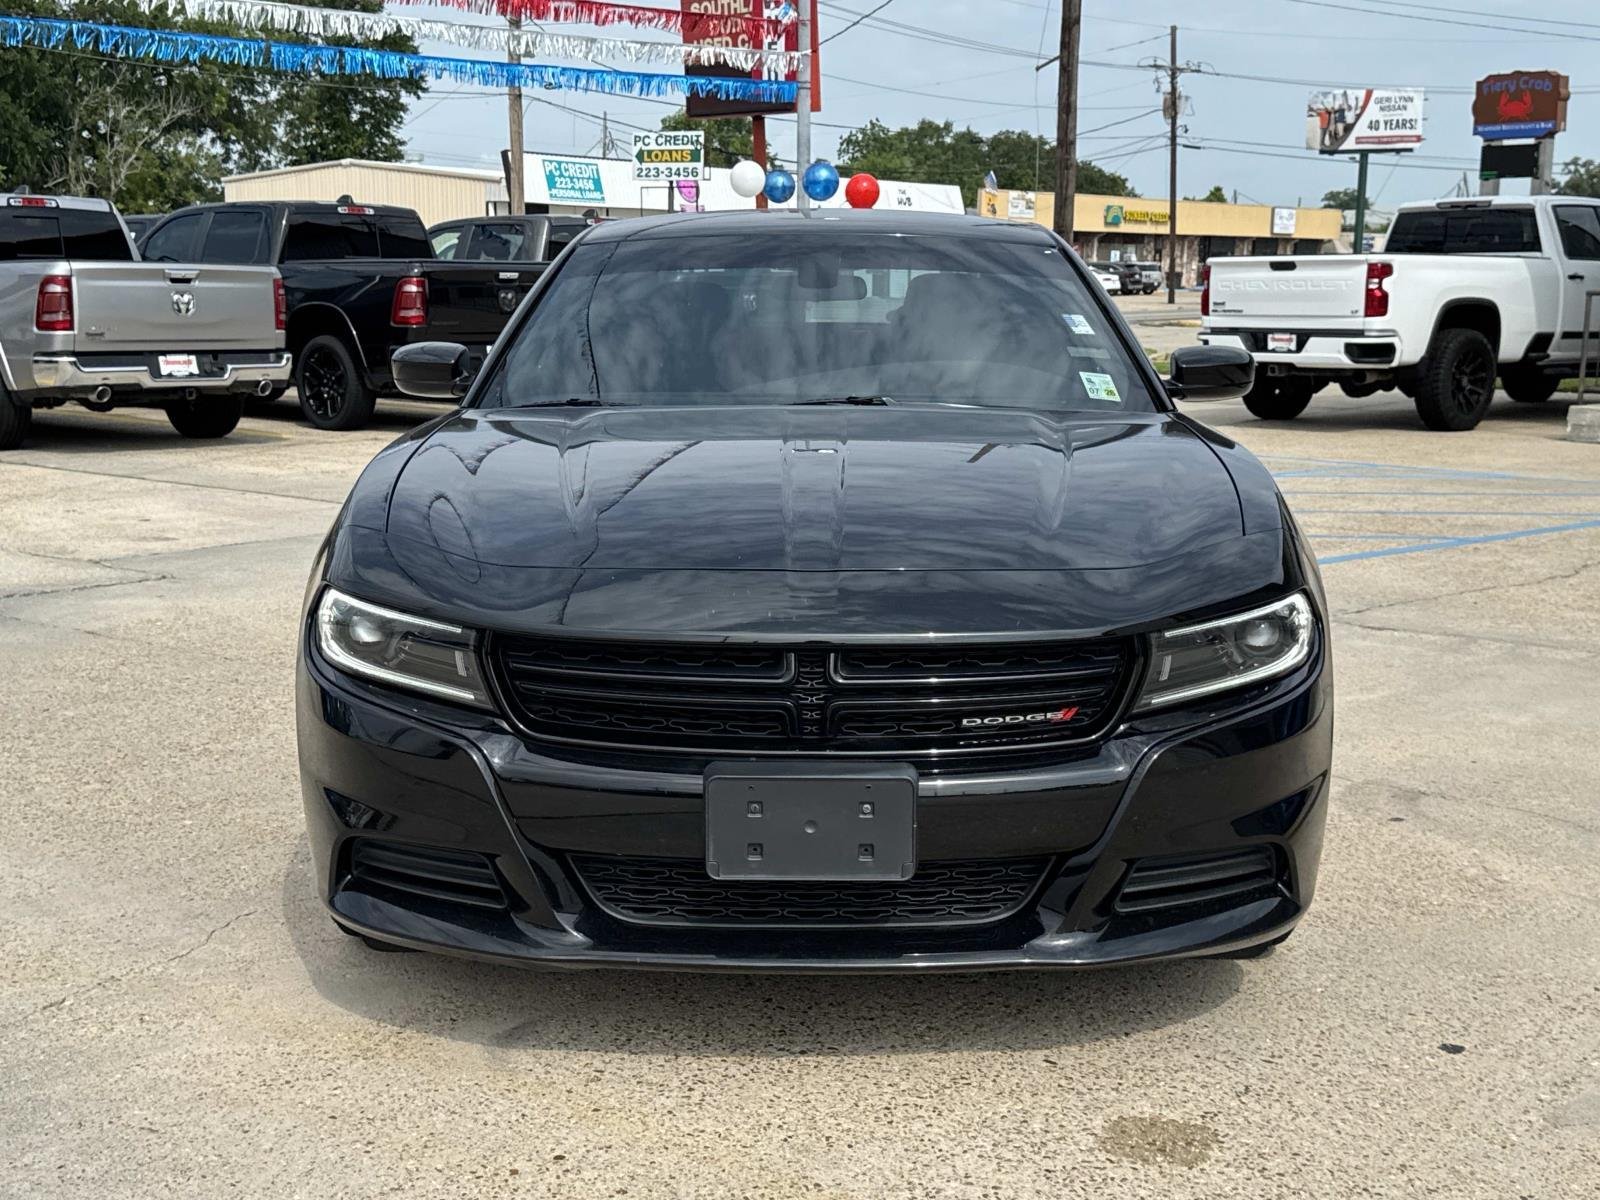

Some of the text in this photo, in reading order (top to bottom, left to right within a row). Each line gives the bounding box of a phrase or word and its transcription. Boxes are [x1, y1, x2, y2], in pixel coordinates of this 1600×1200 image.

[690, 0, 753, 16] SOUTHL
[1519, 76, 1553, 92] Crab
[1374, 95, 1414, 105] GERI LYNN
[1379, 104, 1407, 112] NISSAN
[1367, 118, 1418, 131] 40 YEARS!
[633, 134, 702, 147] PC CREDIT
[643, 150, 691, 162] LOANS
[544, 161, 598, 179] PC CREDIT
[636, 166, 699, 178] 223-3456
[554, 177, 595, 190] 223-3456
[1217, 279, 1354, 291] CHEVROLET
[1088, 387, 1100, 395] 07
[962, 711, 1064, 726] DODGE
